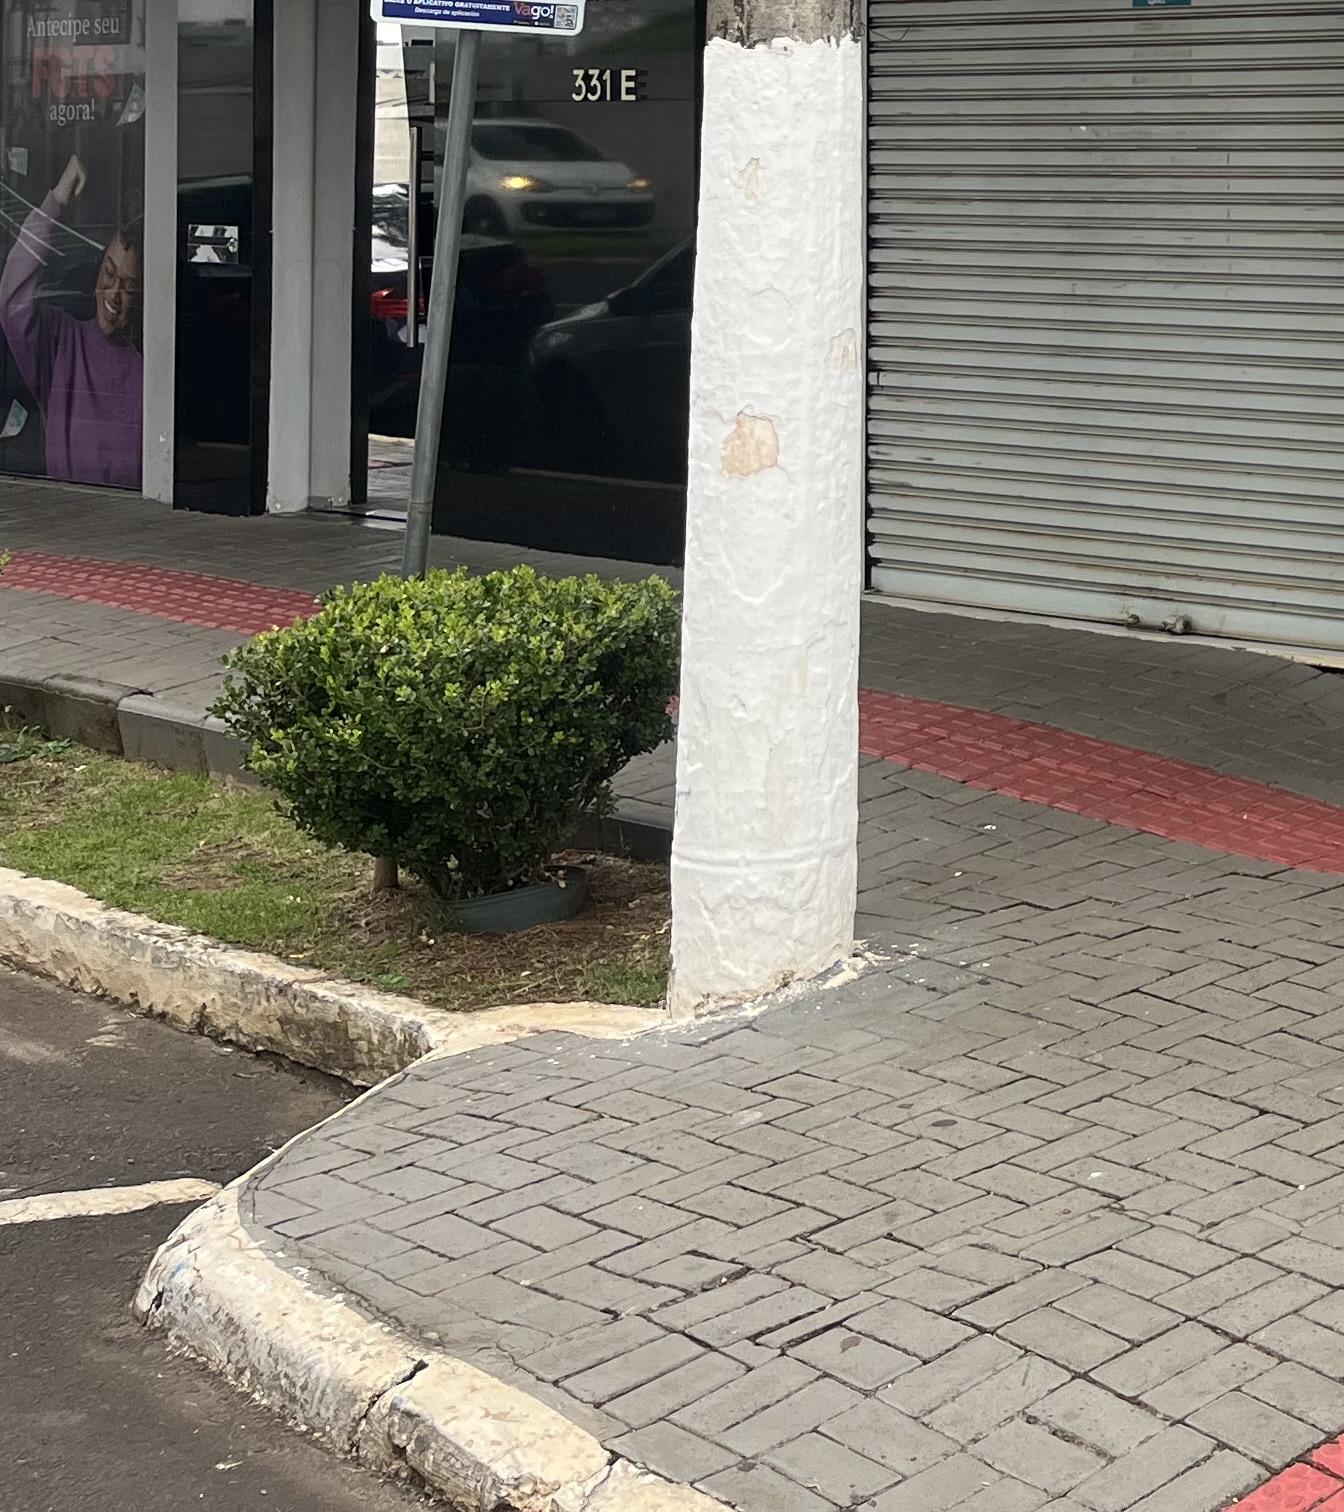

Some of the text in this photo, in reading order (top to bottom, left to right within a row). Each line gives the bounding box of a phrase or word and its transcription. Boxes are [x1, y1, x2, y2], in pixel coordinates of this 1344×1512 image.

[513, 1, 554, 20] Vago!
[26, 12, 120, 43] Antecipe seu
[32, 44, 116, 99] FGTS
[50, 98, 96, 127] agora!
